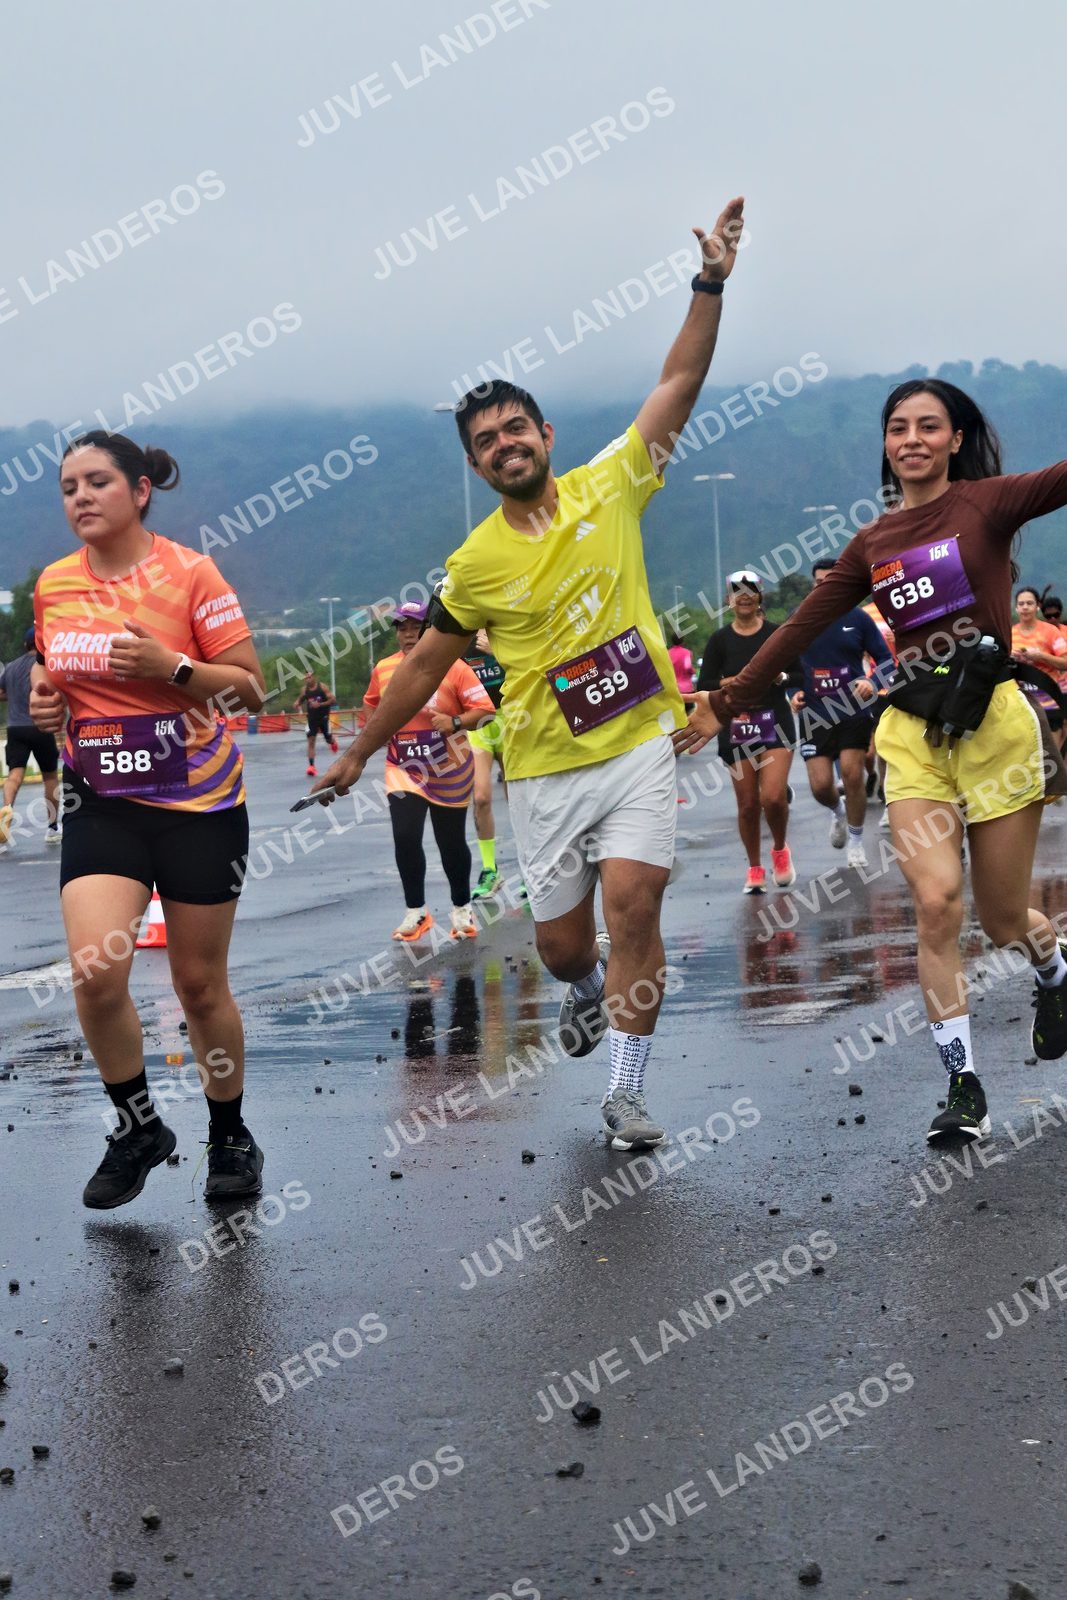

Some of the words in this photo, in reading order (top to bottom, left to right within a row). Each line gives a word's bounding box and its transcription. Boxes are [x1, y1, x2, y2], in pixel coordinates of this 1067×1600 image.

[890, 576, 934, 609] 638
[586, 670, 628, 704] 639
[821, 678, 840, 688] 417
[79, 724, 123, 738] CARRERA
[155, 720, 176, 736] 15K
[740, 724, 761, 736] 174
[406, 744, 430, 756] 413
[100, 750, 152, 774] 588
